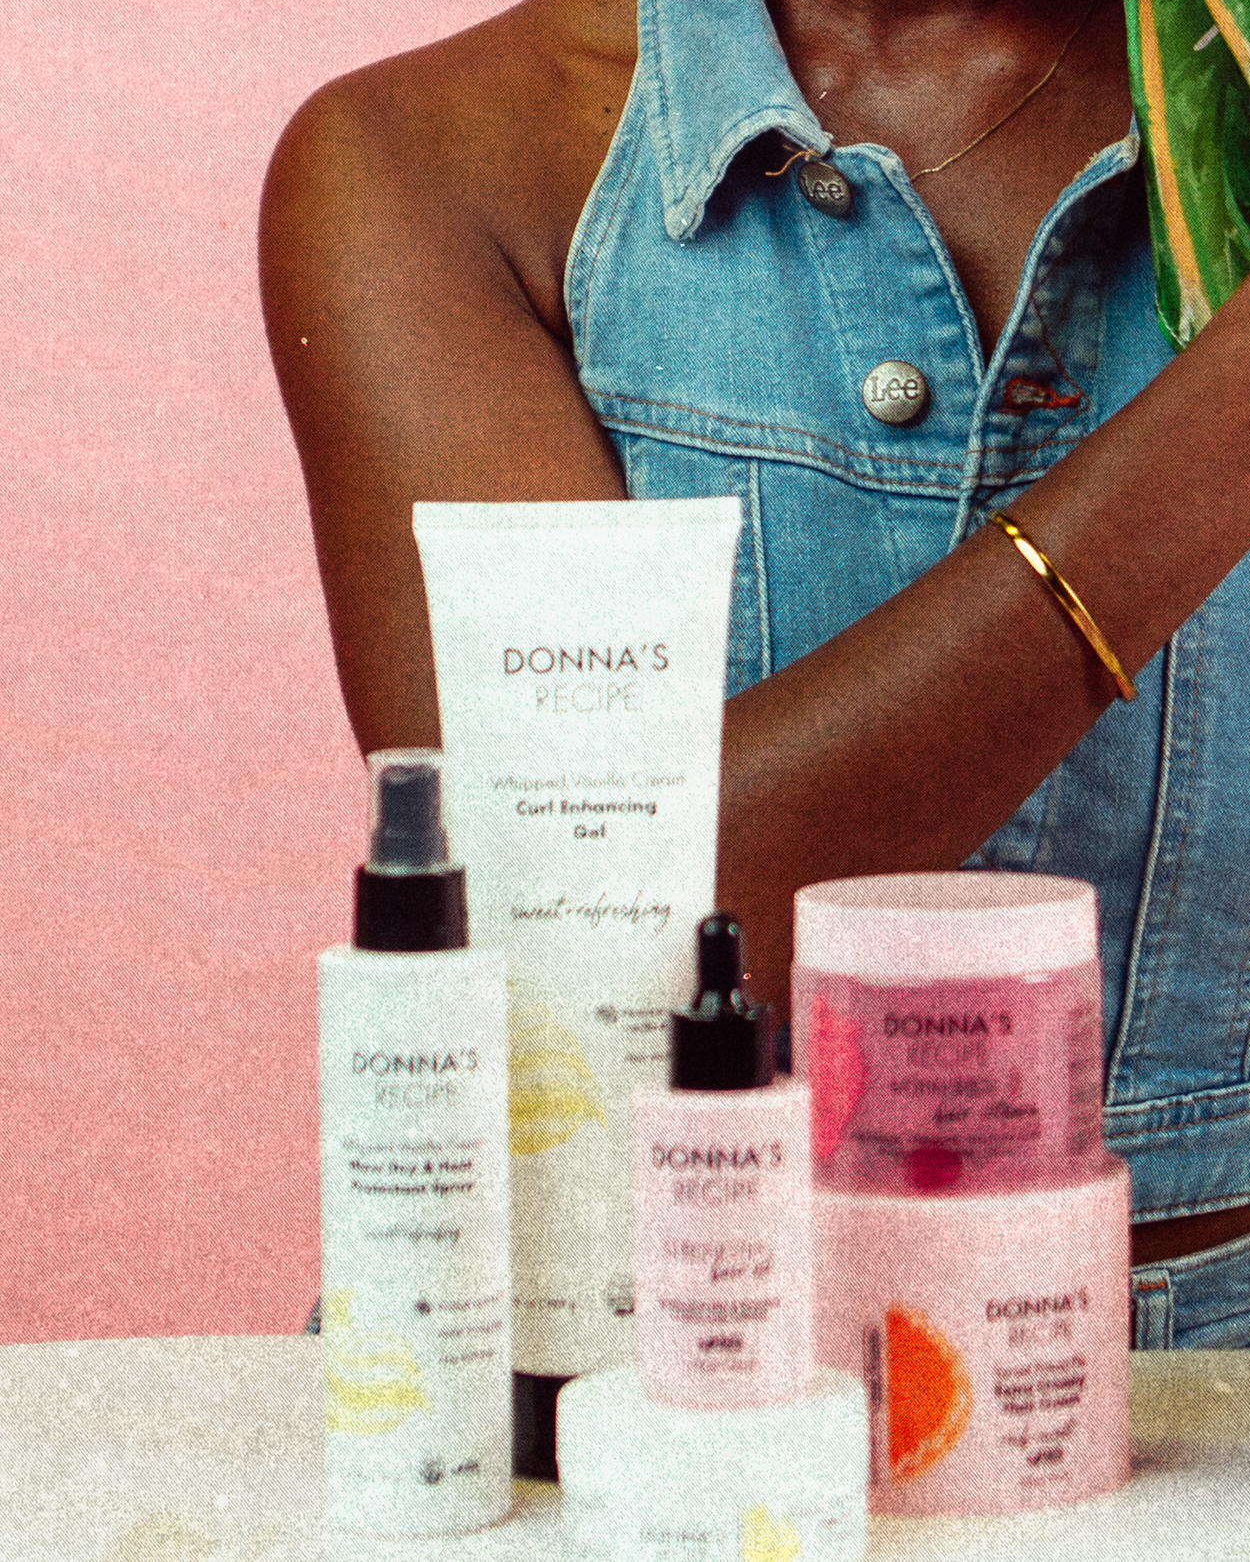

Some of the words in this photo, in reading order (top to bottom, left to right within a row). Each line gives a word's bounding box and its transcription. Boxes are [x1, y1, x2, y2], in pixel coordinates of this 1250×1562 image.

[871, 376, 919, 402] Lee
[504, 644, 669, 675] DONNA'S
[535, 683, 639, 713] RECIPE
[493, 774, 567, 792] Whipped
[572, 772, 626, 789] Vanilla
[631, 770, 686, 788] Cream
[516, 800, 554, 816] Curl
[560, 797, 658, 817] Enhancing
[574, 822, 607, 839] Gel
[884, 1009, 1012, 1039] DONNA'S
[352, 1048, 479, 1077] DONNA'S
[376, 1081, 459, 1109] RECIPE
[652, 1140, 782, 1171] DONNA'S
[674, 1178, 758, 1208] RECIPE
[986, 1288, 1088, 1322] DONNA'S
